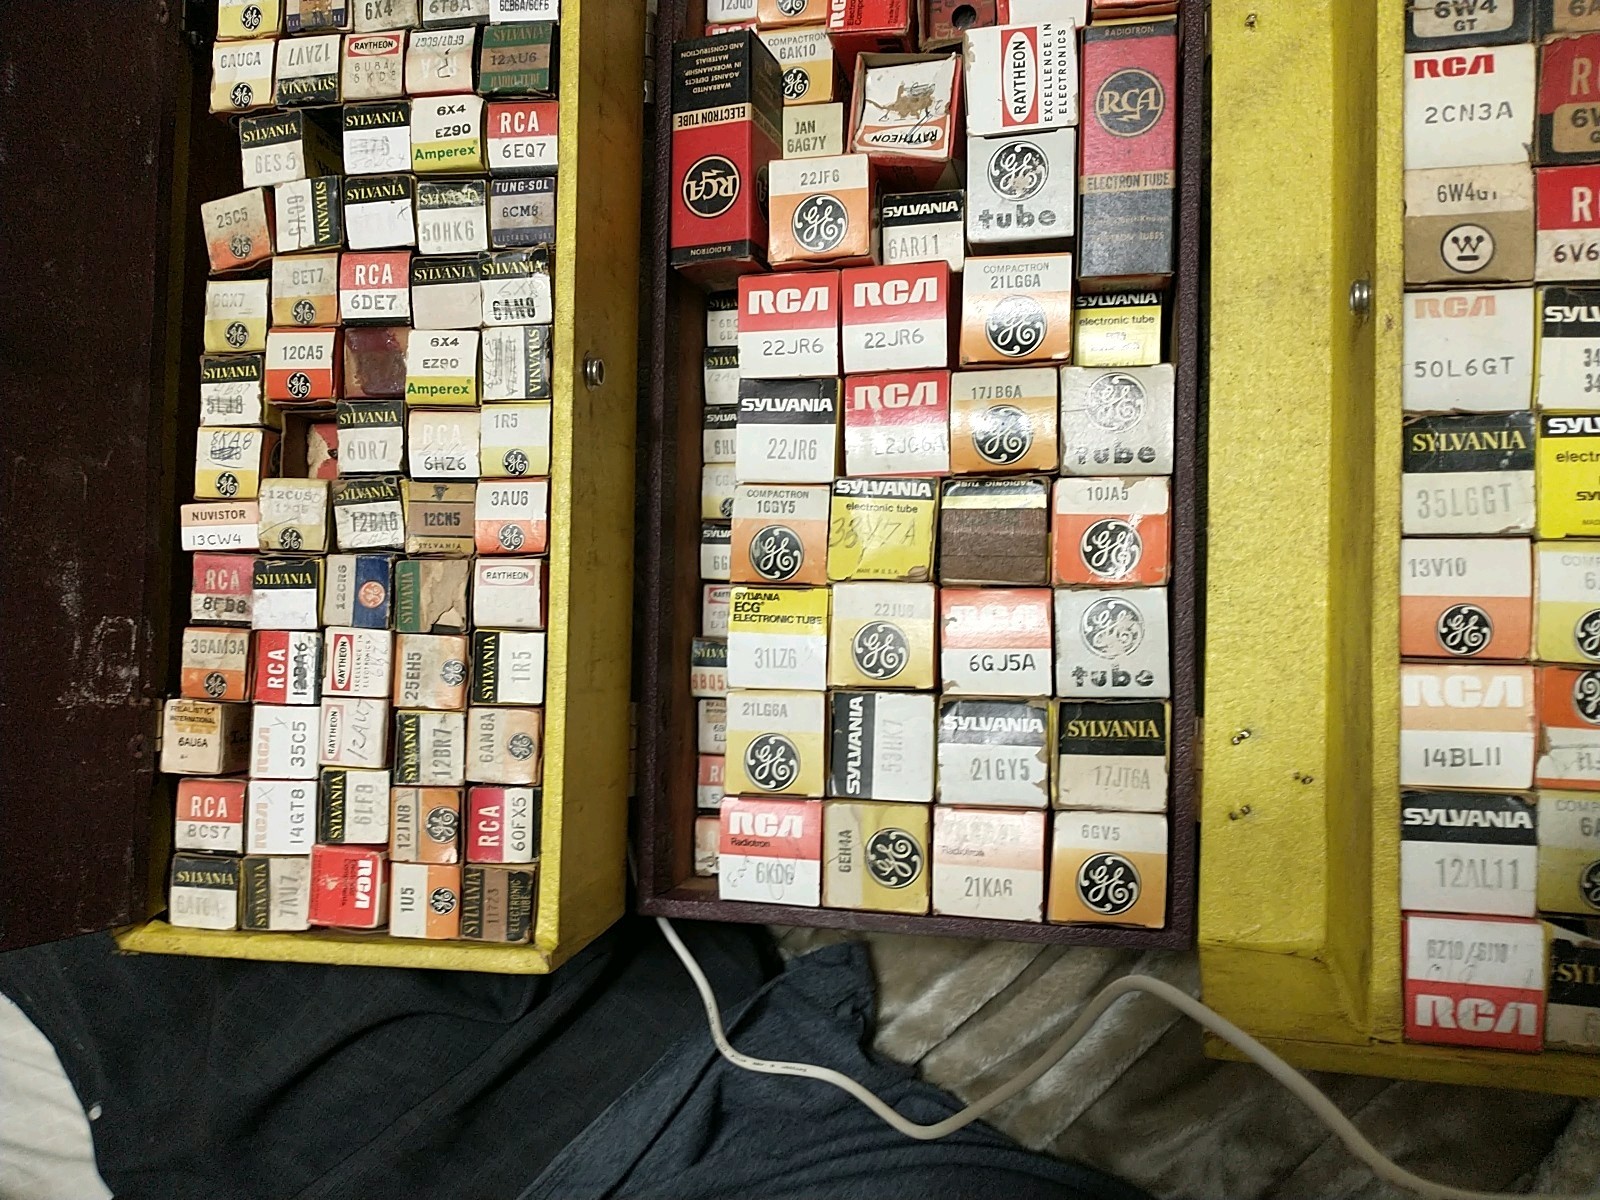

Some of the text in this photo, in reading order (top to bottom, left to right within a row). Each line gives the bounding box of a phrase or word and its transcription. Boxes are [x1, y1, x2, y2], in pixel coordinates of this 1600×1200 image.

[365, 2, 393, 20] 6X4
[494, 27, 542, 39] SYLVANIA
[1105, 25, 1154, 37] RADIOTRON
[1454, 18, 1477, 31] GT
[354, 41, 393, 50] RAYTHEON
[768, 32, 827, 46] COMPACTRON
[288, 43, 329, 66] 12AV7
[491, 52, 537, 65] 12AU6
[681, 42, 745, 58] AND CONSTRUCTION
[779, 44, 815, 59] 6AK10
[696, 54, 729, 65] MATERIALS
[1414, 54, 1495, 79] RCA
[685, 71, 740, 86] AGAINST DEFECTS
[1013, 40, 1027, 115] RAYTHEON
[1044, 23, 1053, 122] EXCELLENCE IN
[1058, 29, 1067, 115] ELECTRONICS
[280, 78, 335, 95] SYLVANIA
[693, 82, 731, 93] WARRANTED
[437, 104, 467, 116] 6X4
[1100, 87, 1160, 121] RCA
[1425, 101, 1513, 124] 2CN3A
[346, 111, 404, 127] SYLVANIA
[500, 111, 540, 133] RCA
[678, 106, 745, 127] ELECTRON TUBE
[243, 122, 297, 142] SYLVANIA
[435, 123, 471, 138] EZ90
[795, 120, 816, 135] JAN
[872, 129, 938, 144] RAYTHEON
[415, 144, 476, 161] Amperex
[502, 143, 547, 159] 6EQ7
[787, 136, 827, 153] 6AG7Y
[495, 180, 549, 194] TUNG-SOL
[687, 169, 738, 201] RCA
[800, 169, 840, 187] 22JF6
[1087, 172, 1169, 191] ELECTRON TUBE
[347, 184, 404, 200] SYLVANIA
[217, 208, 248, 228] 25C5
[316, 181, 331, 243] SYLVANIA
[502, 205, 538, 217] 6CM8
[883, 201, 959, 218] SYLVANIA
[978, 204, 1056, 229] tube
[690, 245, 731, 256] RADIOTRON
[888, 234, 939, 260] 6AR11
[353, 263, 393, 287] RCA
[415, 266, 475, 280] SYLVANIA
[482, 261, 543, 275] SYLVANIA
[983, 262, 1050, 274] COMPACTRON
[990, 275, 1041, 290] 21LG6A
[748, 286, 829, 315] RCA
[854, 276, 937, 308] RCA
[1076, 293, 1158, 308] SYLVANIA
[351, 294, 397, 310] 6DE7
[1414, 296, 1496, 319] RCA
[1079, 315, 1155, 326] electronic tube
[430, 337, 459, 347] 6X4
[762, 337, 824, 356] 22JR6
[864, 328, 925, 350] 22JR6
[282, 346, 322, 361] 12CA5
[528, 328, 541, 393] SYLVANIA
[203, 365, 257, 379] SYLVANIA
[422, 358, 459, 369] EZ90
[1414, 357, 1514, 378] 50L6GT
[407, 381, 469, 397] Amperex
[854, 380, 937, 411] RCA
[971, 385, 1022, 400] 17JB6A
[741, 398, 833, 412] SYLVANIA
[339, 410, 397, 424] SYLVANIA
[494, 413, 518, 429] 1R5
[423, 423, 460, 443] RCA
[1413, 430, 1526, 451] SYLVANIA
[767, 438, 817, 460] 22JR6
[424, 456, 466, 471] 6HZ6
[337, 485, 394, 500] SYLVANIA
[747, 489, 809, 499] COMPACTRON
[836, 479, 932, 497] SYLVANIA
[1087, 486, 1129, 501] 10JA5
[491, 491, 528, 505] 3AU6
[192, 510, 246, 521] NUVISTOR
[846, 502, 918, 514] electronic tube
[486, 572, 528, 580] RAYTHEON
[1409, 557, 1467, 578] 13V10
[205, 569, 240, 590] RCA
[255, 573, 312, 586] SYLVANIA
[735, 592, 780, 602] SYLVANIA
[733, 614, 822, 625] ELECTRONIC TUBE
[338, 641, 347, 684] RAYTHEON
[482, 635, 495, 699] SYLVANIA
[511, 651, 531, 683] 1R5
[754, 648, 797, 670] 31LZ6
[969, 653, 1036, 672] 6GJ5A
[267, 649, 285, 688] RCA
[405, 652, 421, 700] 25EH5
[1071, 664, 1154, 688] tube
[1402, 674, 1524, 708] RCA
[741, 702, 788, 718] 21LG6A
[328, 711, 337, 754] RAYTHEON
[941, 715, 1044, 733] SYLVANIA
[1068, 719, 1160, 738] SYLVANIA
[290, 721, 306, 767] 35C5
[403, 717, 417, 781] SYLVANIA
[432, 728, 452, 777] 12BR7
[846, 696, 864, 795] SYLVANIA
[971, 757, 1030, 781] 21GY5
[190, 796, 228, 818] RCA
[330, 773, 344, 839] SYLVANIA
[290, 788, 305, 843] 14GT8
[511, 797, 527, 851] 60FX5
[729, 811, 804, 838] RCA
[1402, 807, 1533, 829] SYLVANIA
[187, 824, 230, 839] 8CS7
[477, 805, 500, 847] RCA
[1081, 823, 1120, 841] 6GV5
[731, 838, 770, 848] Radiotron
[175, 868, 235, 885] SYLVANIA
[354, 859, 373, 909] RCA
[254, 864, 266, 926] SYLVANIA
[400, 887, 416, 911] 1U5
[463, 872, 480, 934] SYLVANIA
[519, 881, 530, 912] TUBE
[509, 879, 520, 933] ELECTRONIC
[1415, 994, 1537, 1036] RCA
